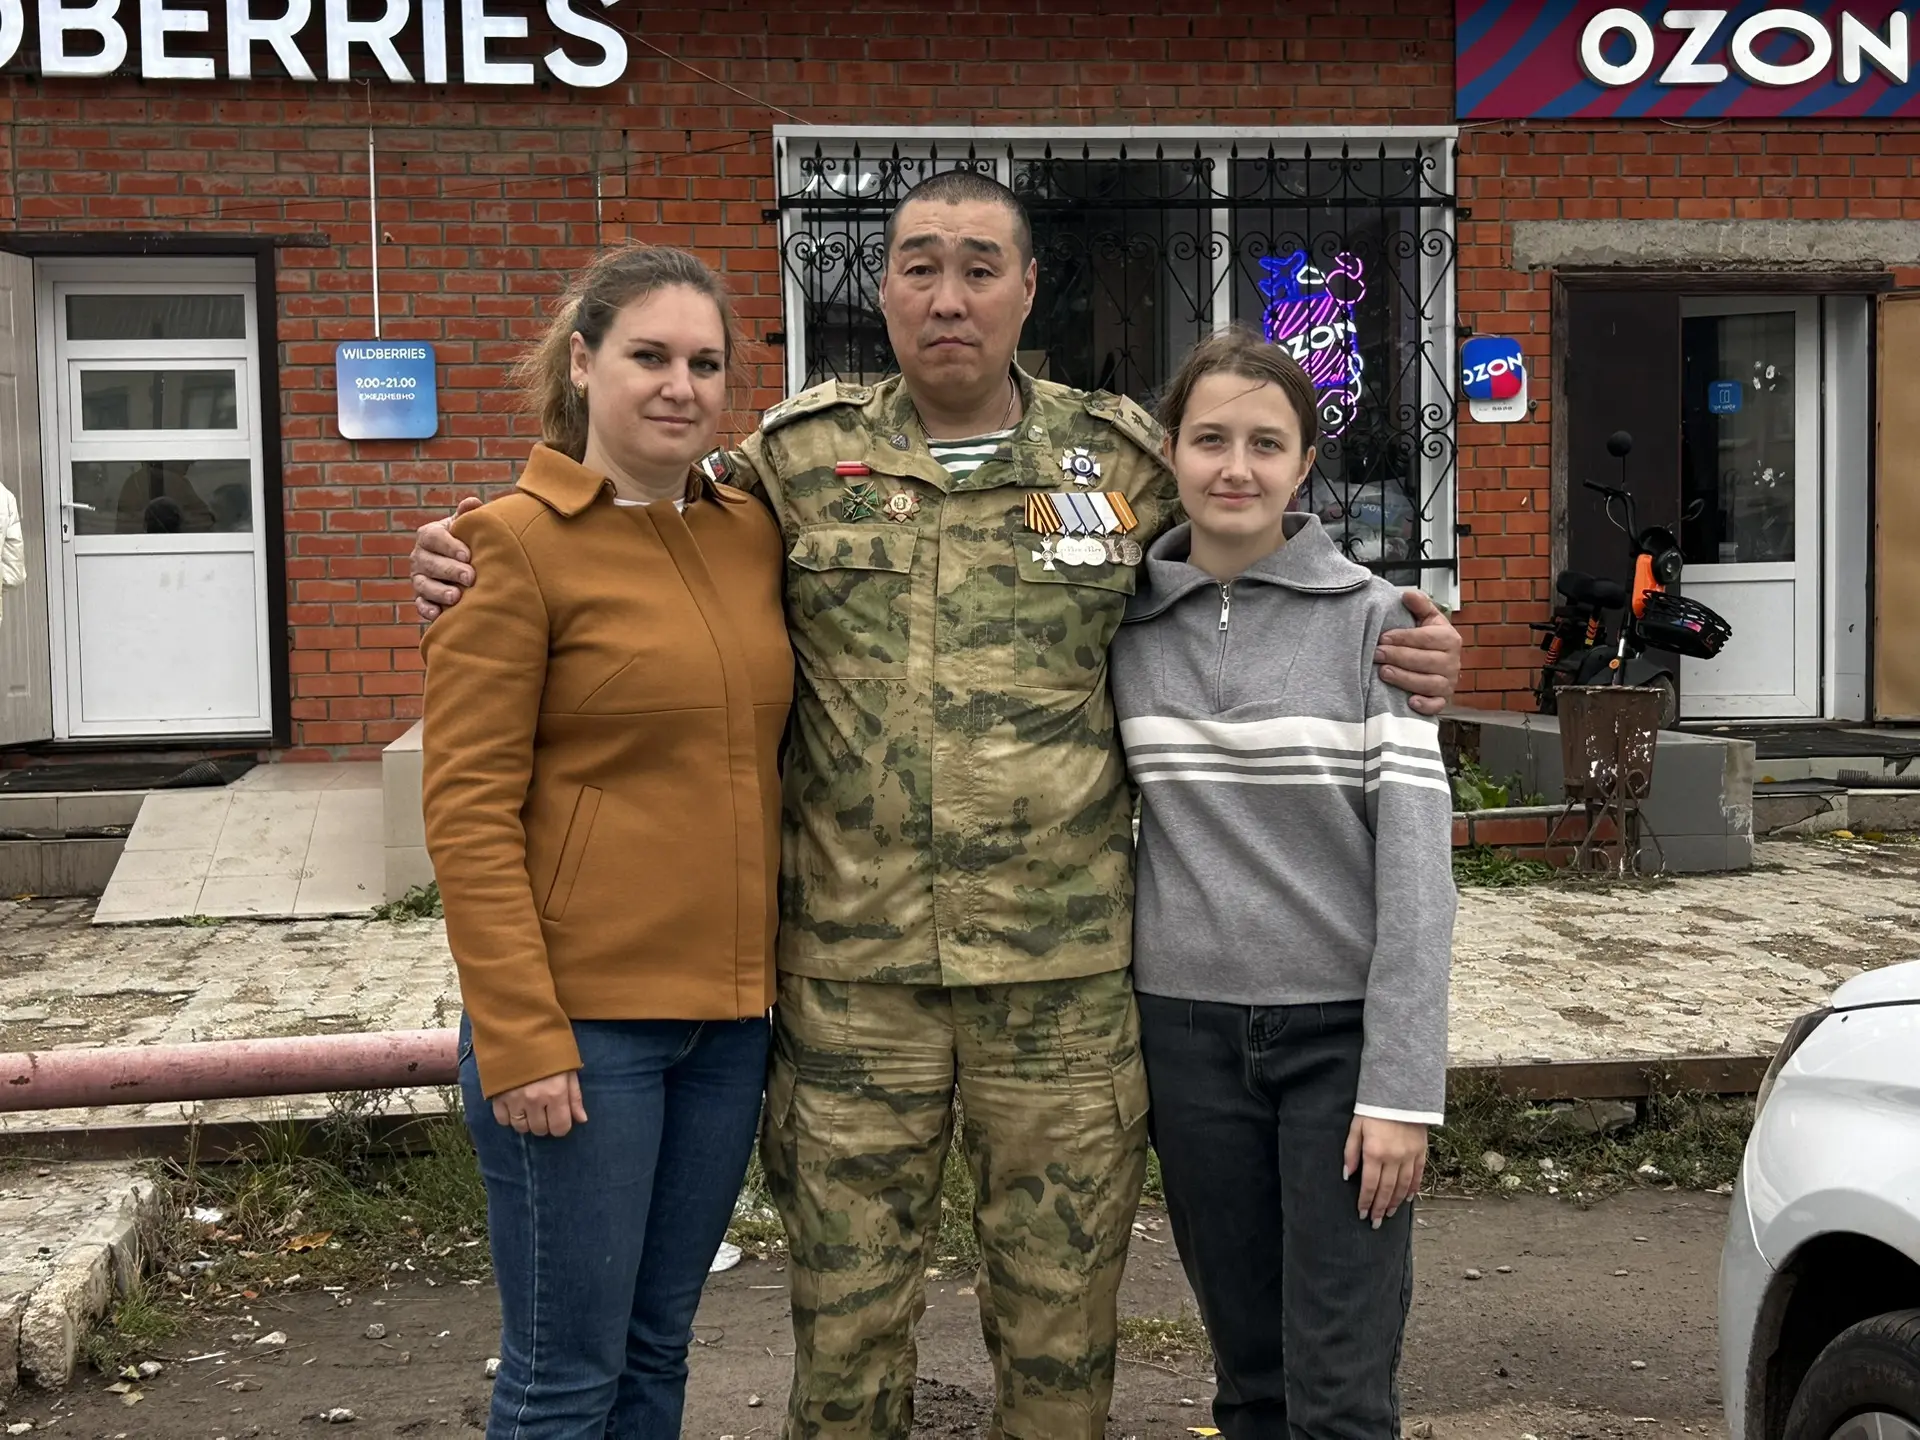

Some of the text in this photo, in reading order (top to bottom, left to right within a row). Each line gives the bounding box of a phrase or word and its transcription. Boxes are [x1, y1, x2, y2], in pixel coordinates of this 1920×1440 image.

[0, 0, 628, 88] BERRIES
[1580, 7, 1908, 86] OZON
[342, 348, 426, 359] WILDBERRIES
[355, 377, 416, 388] 9.00-21.00
